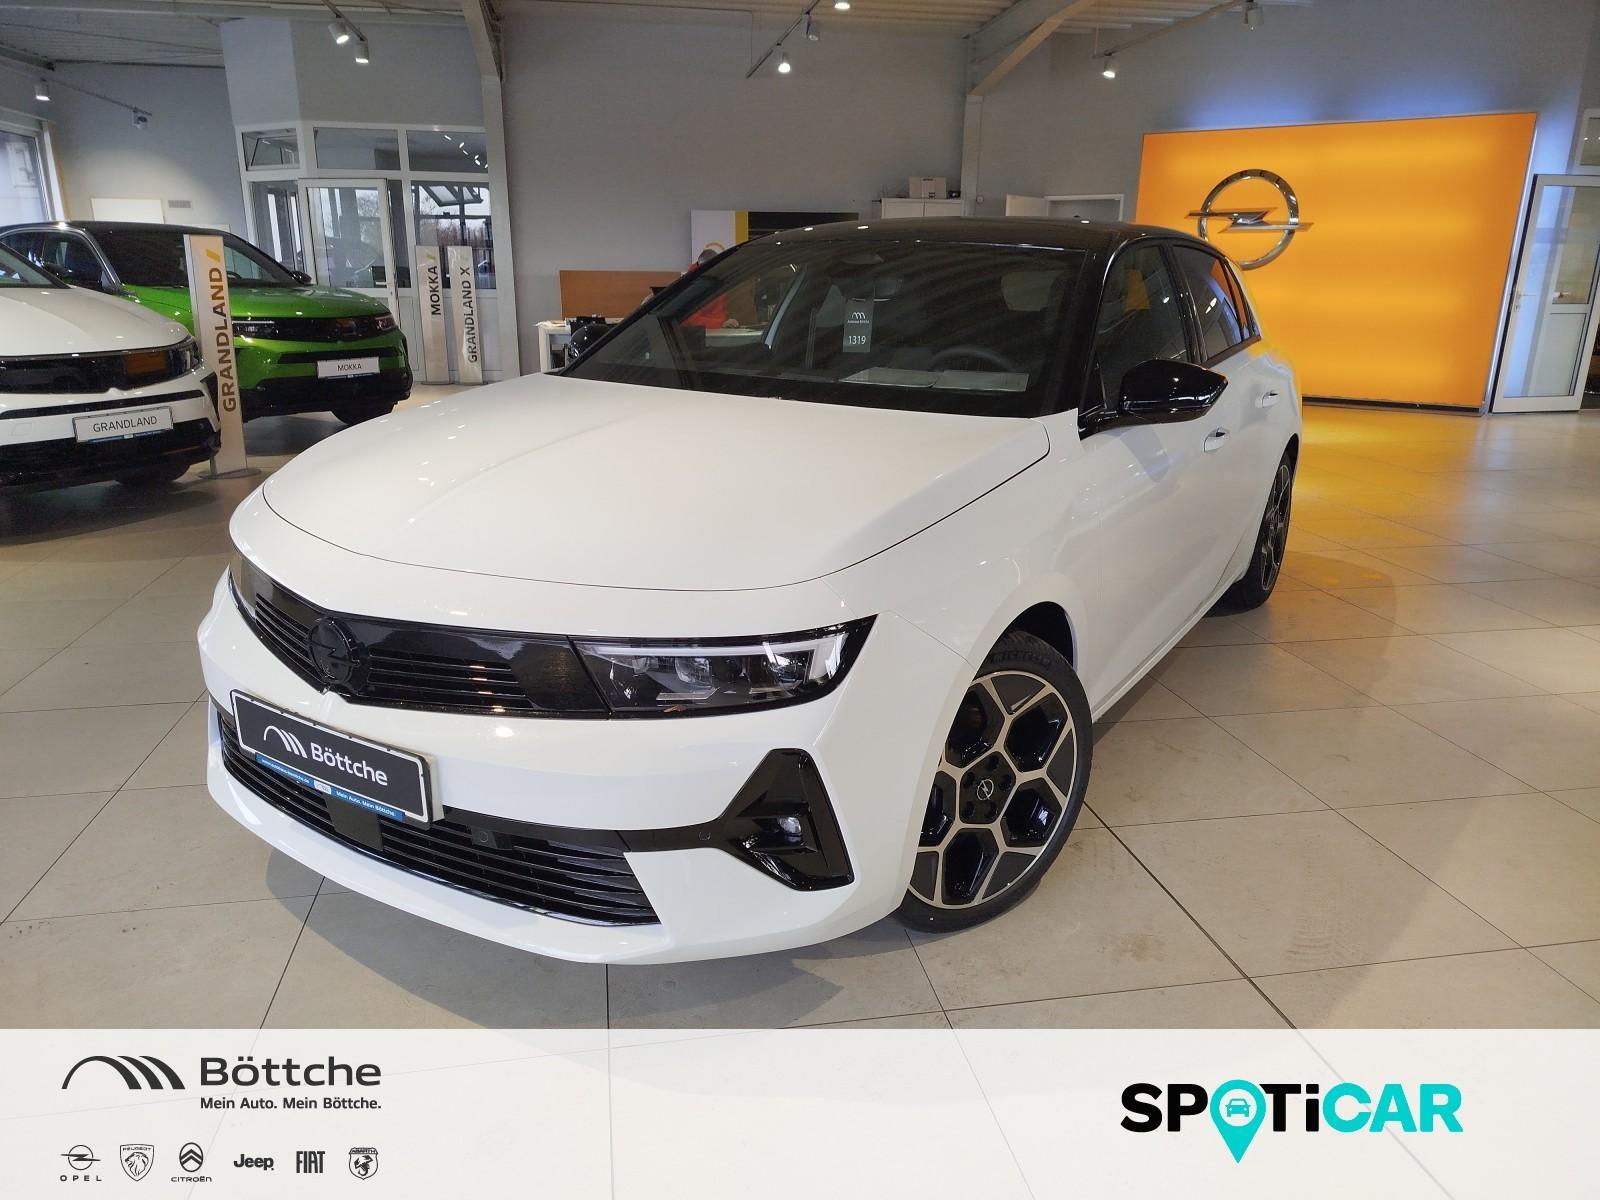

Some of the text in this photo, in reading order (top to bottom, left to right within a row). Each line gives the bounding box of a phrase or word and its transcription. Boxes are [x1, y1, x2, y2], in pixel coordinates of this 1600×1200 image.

[427, 265, 442, 316] MOKKA
[460, 266, 478, 363] GRANDLAND X
[208, 267, 237, 412] GRANDLAND
[848, 335, 867, 345] 1319
[337, 363, 362, 371] MOKKA
[92, 415, 158, 433] GRANDLAND
[310, 742, 388, 786] Böttche
